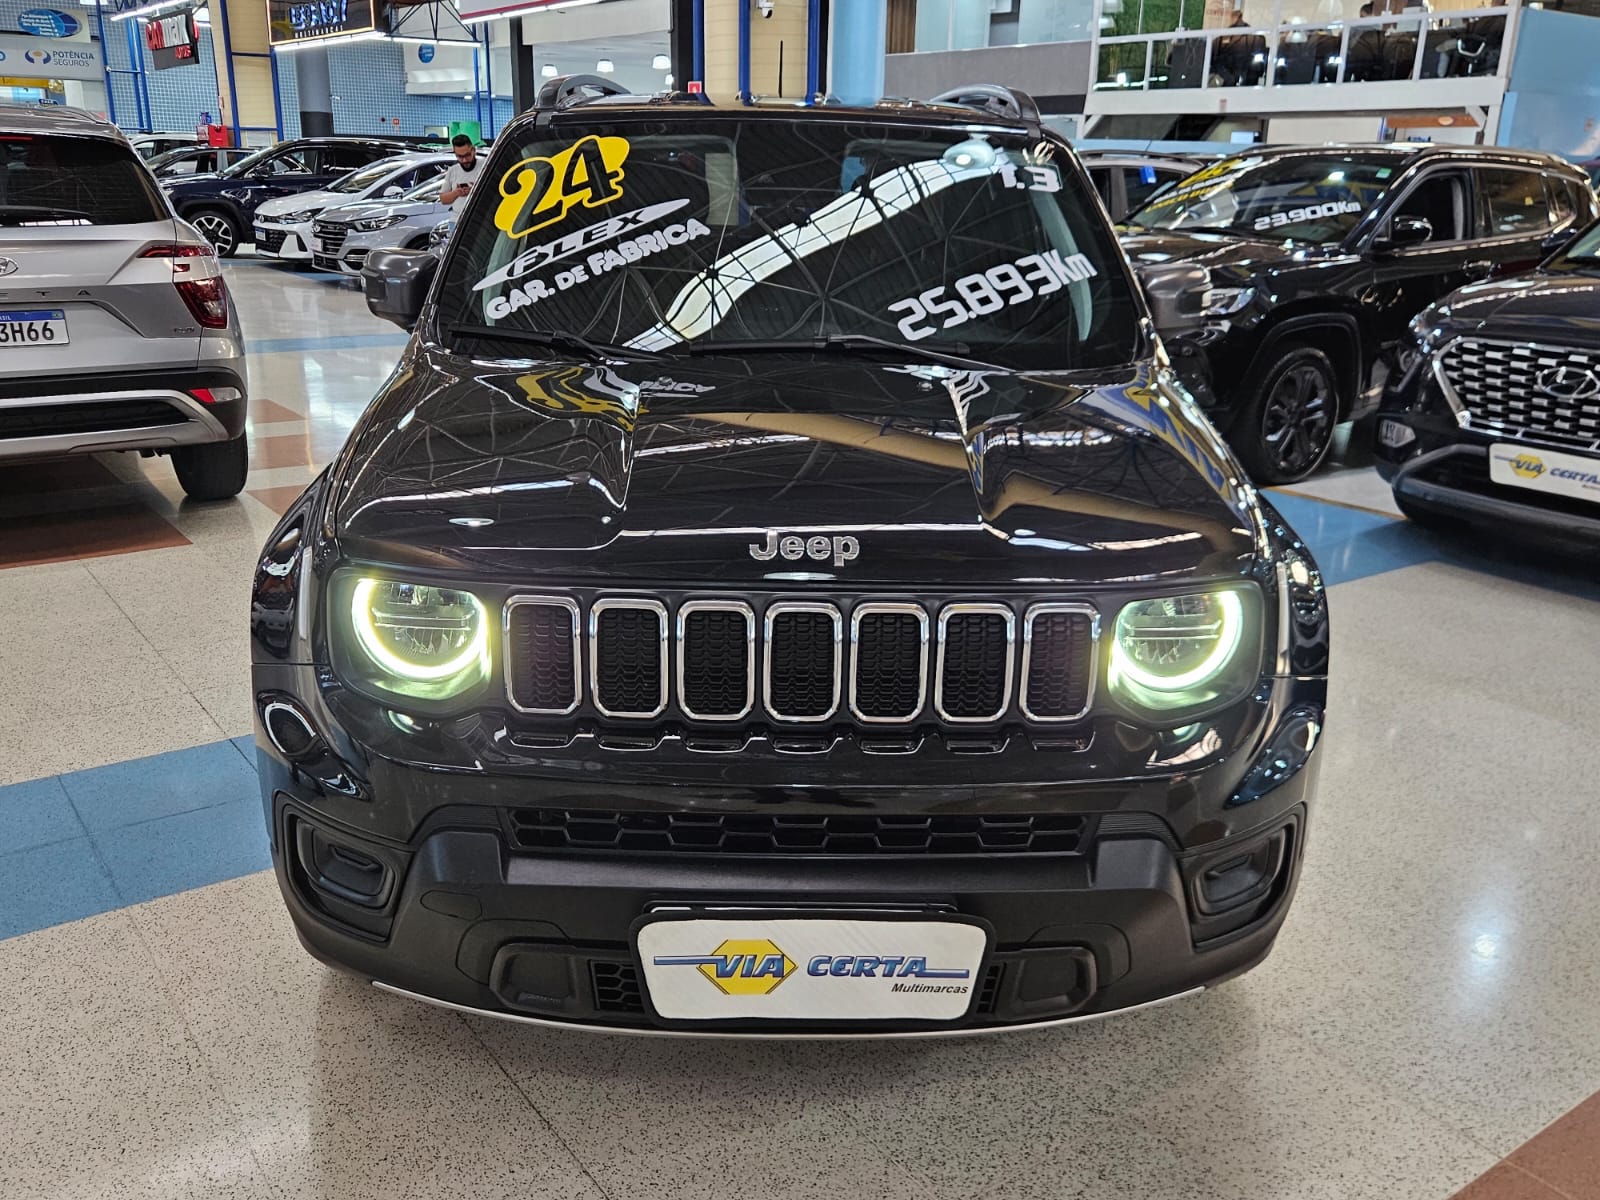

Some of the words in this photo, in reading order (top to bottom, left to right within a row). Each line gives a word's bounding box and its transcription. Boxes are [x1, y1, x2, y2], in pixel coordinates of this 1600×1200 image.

[52, 50, 95, 60] POTÊNCIA
[53, 59, 90, 67] SEGUROS
[497, 135, 626, 238] 24
[999, 163, 1063, 193] 1.3
[1254, 201, 1362, 231] 23.900Km
[486, 279, 556, 320] GAR.
[555, 264, 590, 291] DE
[887, 249, 1098, 341] 25.893Km
[1514, 459, 1543, 474] VIA
[1549, 467, 1599, 484] CERTA
[748, 529, 860, 567] Jeep
[715, 954, 785, 979] VIA
[806, 954, 928, 979] CERTA
[890, 982, 969, 995] Multimarcas
